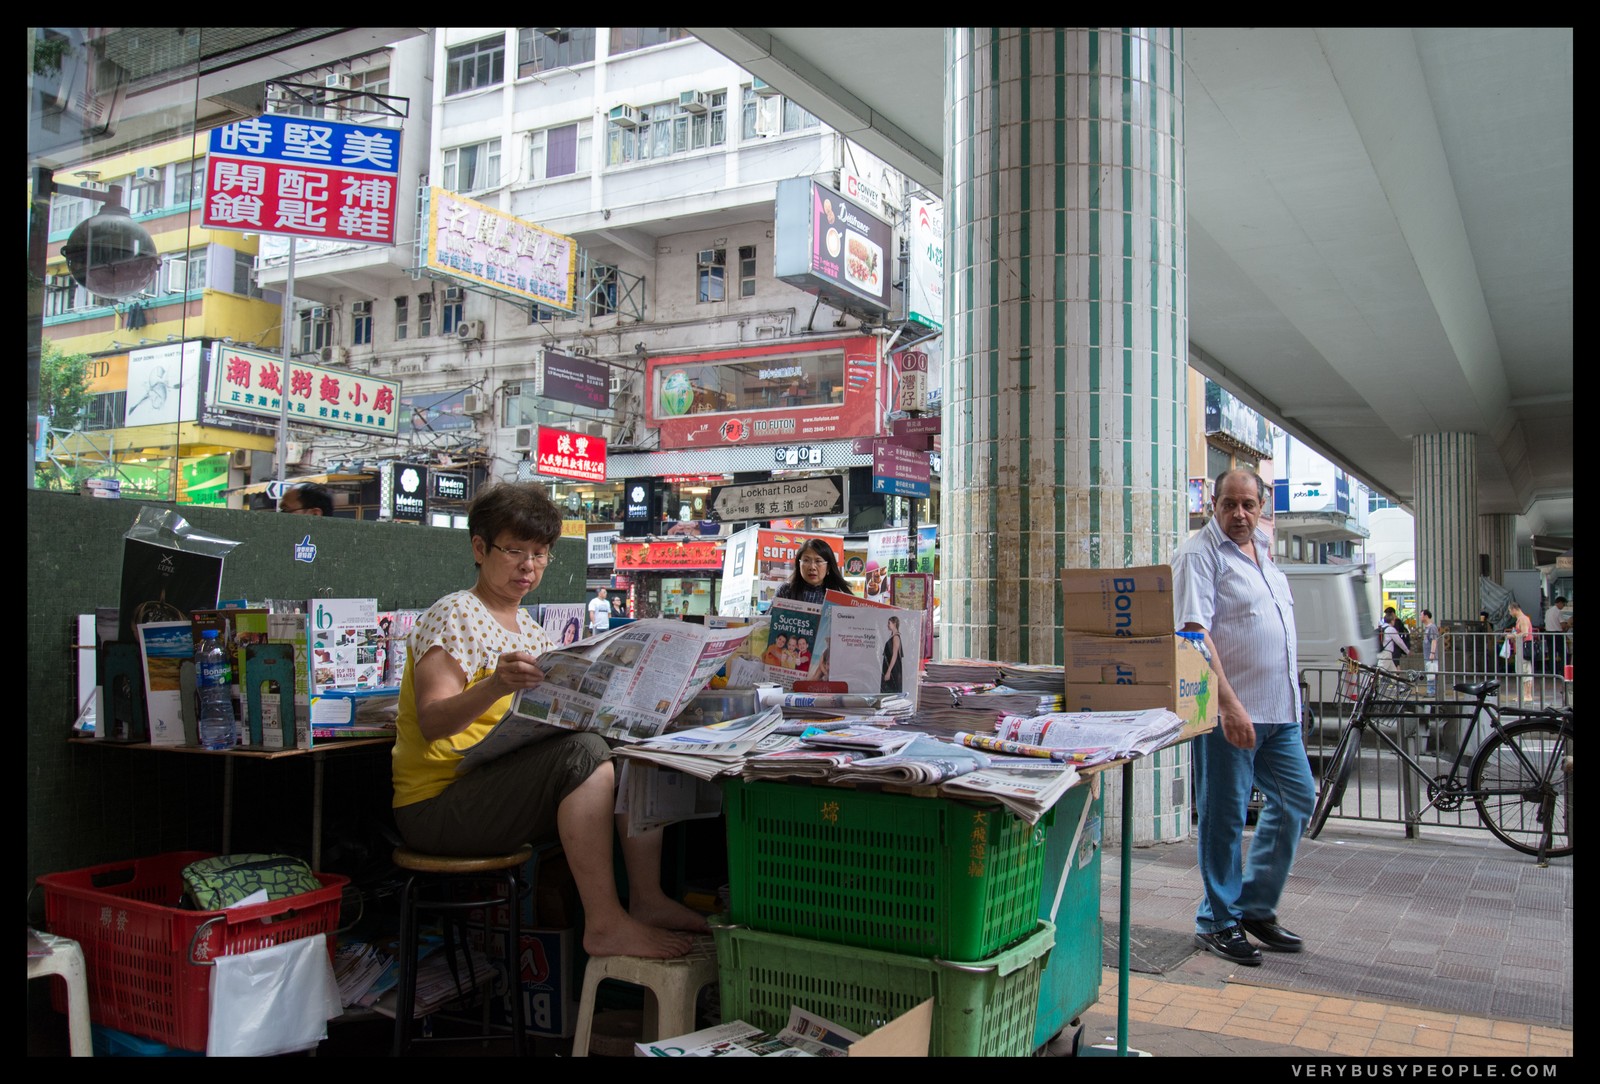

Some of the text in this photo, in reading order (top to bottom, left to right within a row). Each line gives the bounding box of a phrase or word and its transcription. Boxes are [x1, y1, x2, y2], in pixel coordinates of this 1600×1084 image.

[857, 182, 879, 200] CONVEY
[226, 356, 395, 415] 潮城粥麵小廚
[902, 374, 916, 406] 灣仔
[754, 419, 795, 430] ITO FUTON
[557, 434, 589, 458] 港豐
[439, 477, 464, 489] Modern
[439, 486, 463, 495] Classic
[741, 484, 808, 498] Lockhart Road
[396, 494, 423, 506] Modern
[754, 500, 794, 514] 駱克道
[396, 504, 423, 513] Classic
[888, 556, 930, 573] 點點思
[546, 607, 584, 620] HONG KONG
[779, 614, 810, 628] SUCCESS
[773, 622, 814, 637] STARTS HERE
